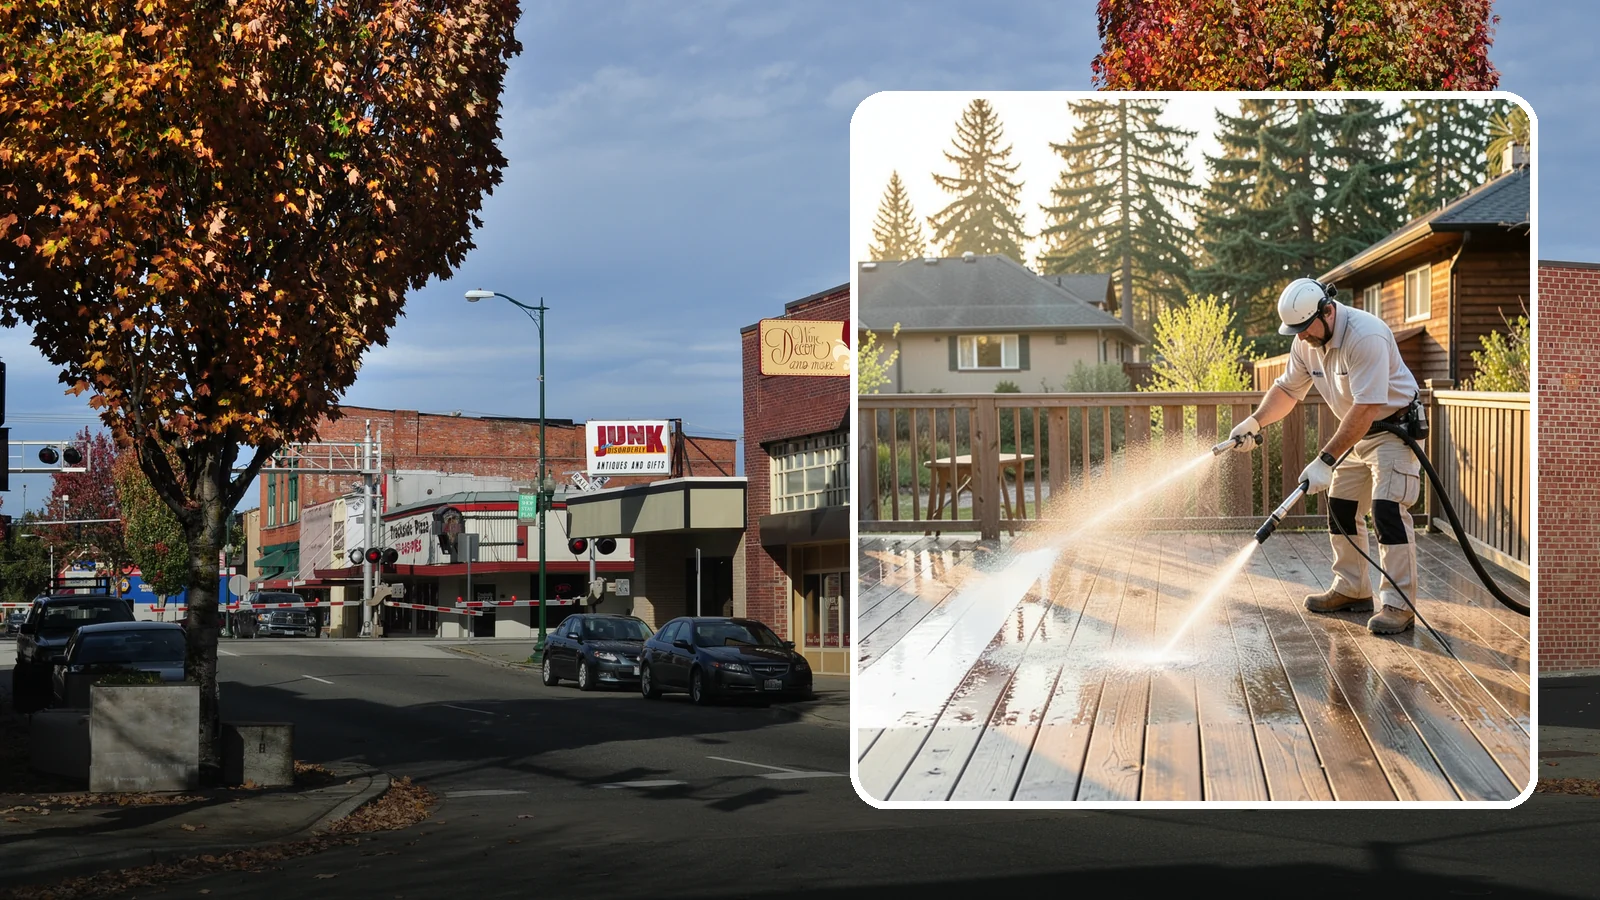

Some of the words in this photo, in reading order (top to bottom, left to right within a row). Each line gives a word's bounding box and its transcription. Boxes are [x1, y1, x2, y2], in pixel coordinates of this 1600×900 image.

[765, 328, 831, 365] Decor
[595, 425, 665, 457] JUNK
[607, 446, 646, 454] DISORDERLY
[597, 461, 628, 470] ANTIQUES
[631, 461, 644, 470] AND
[647, 460, 665, 470] GIFTS
[390, 521, 413, 539] Trackside
[414, 520, 429, 534] Pizza
